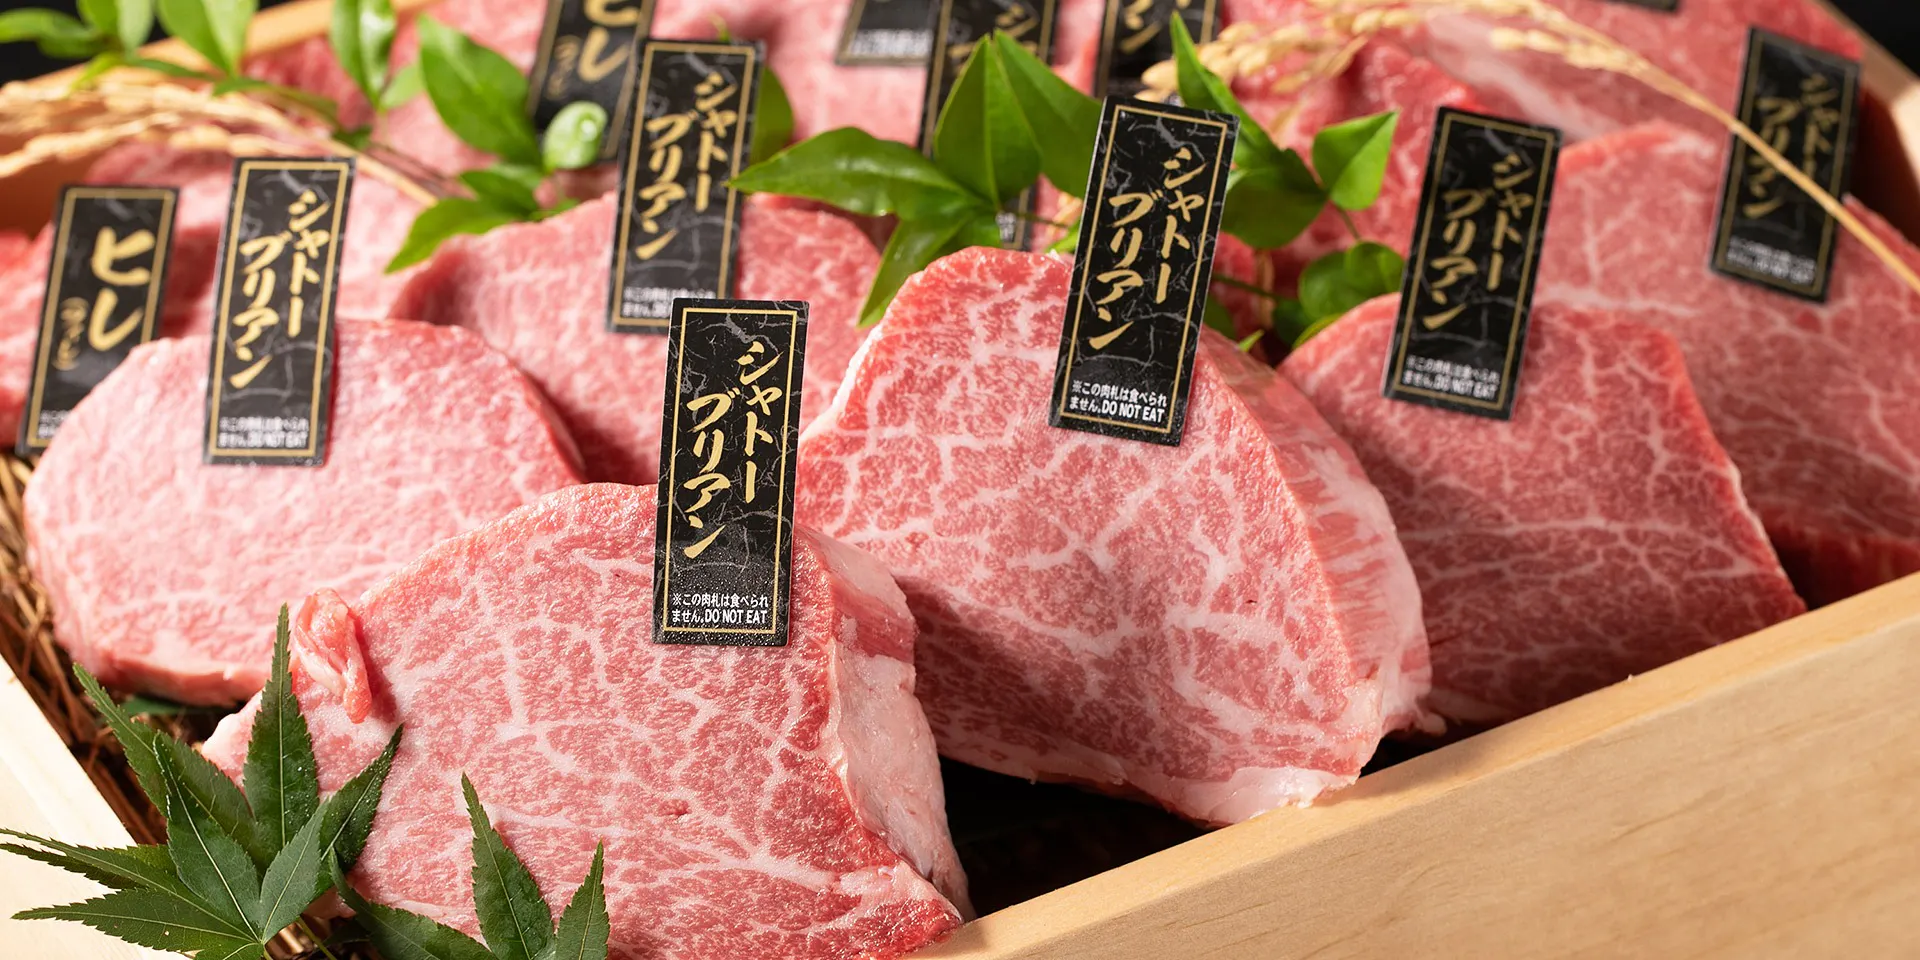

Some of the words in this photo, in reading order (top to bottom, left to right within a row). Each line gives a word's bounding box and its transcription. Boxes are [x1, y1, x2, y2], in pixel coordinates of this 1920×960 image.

[636, 110, 697, 260] ブリアン
[695, 72, 738, 212] シャトー
[88, 226, 155, 351] ヒレ
[287, 189, 331, 338] シャトー
[1089, 189, 1163, 350] ブリアン
[1156, 147, 1207, 304] シャトー
[1423, 187, 1496, 331] ブリアン
[1487, 153, 1535, 291] シャトー
[230, 230, 293, 389] ブリアン
[682, 387, 741, 559] ブリアン
[736, 341, 785, 504] シャトー
[1119, 403, 1142, 419] NOT
[1142, 406, 1165, 423] EAT
[672, 592, 769, 608] ※この肉札は食べられ
[722, 609, 744, 624] NOT
[746, 609, 768, 624] EAT
